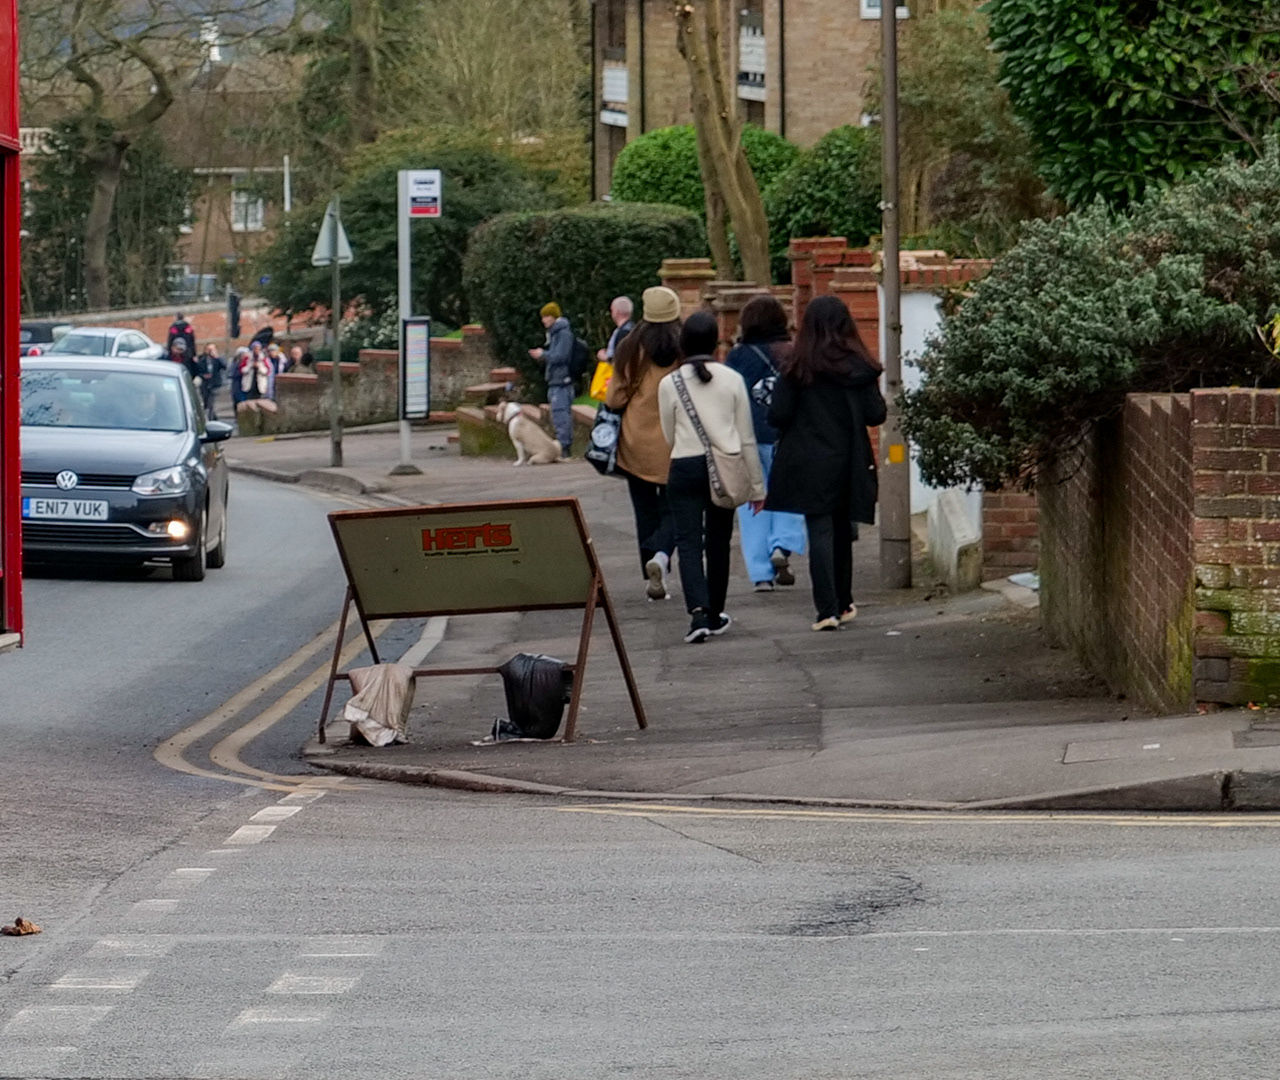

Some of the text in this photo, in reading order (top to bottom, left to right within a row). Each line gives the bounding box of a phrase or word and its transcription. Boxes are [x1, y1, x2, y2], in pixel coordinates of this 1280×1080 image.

[35, 500, 103, 516] EN17 VUK
[421, 523, 512, 551] Herts
